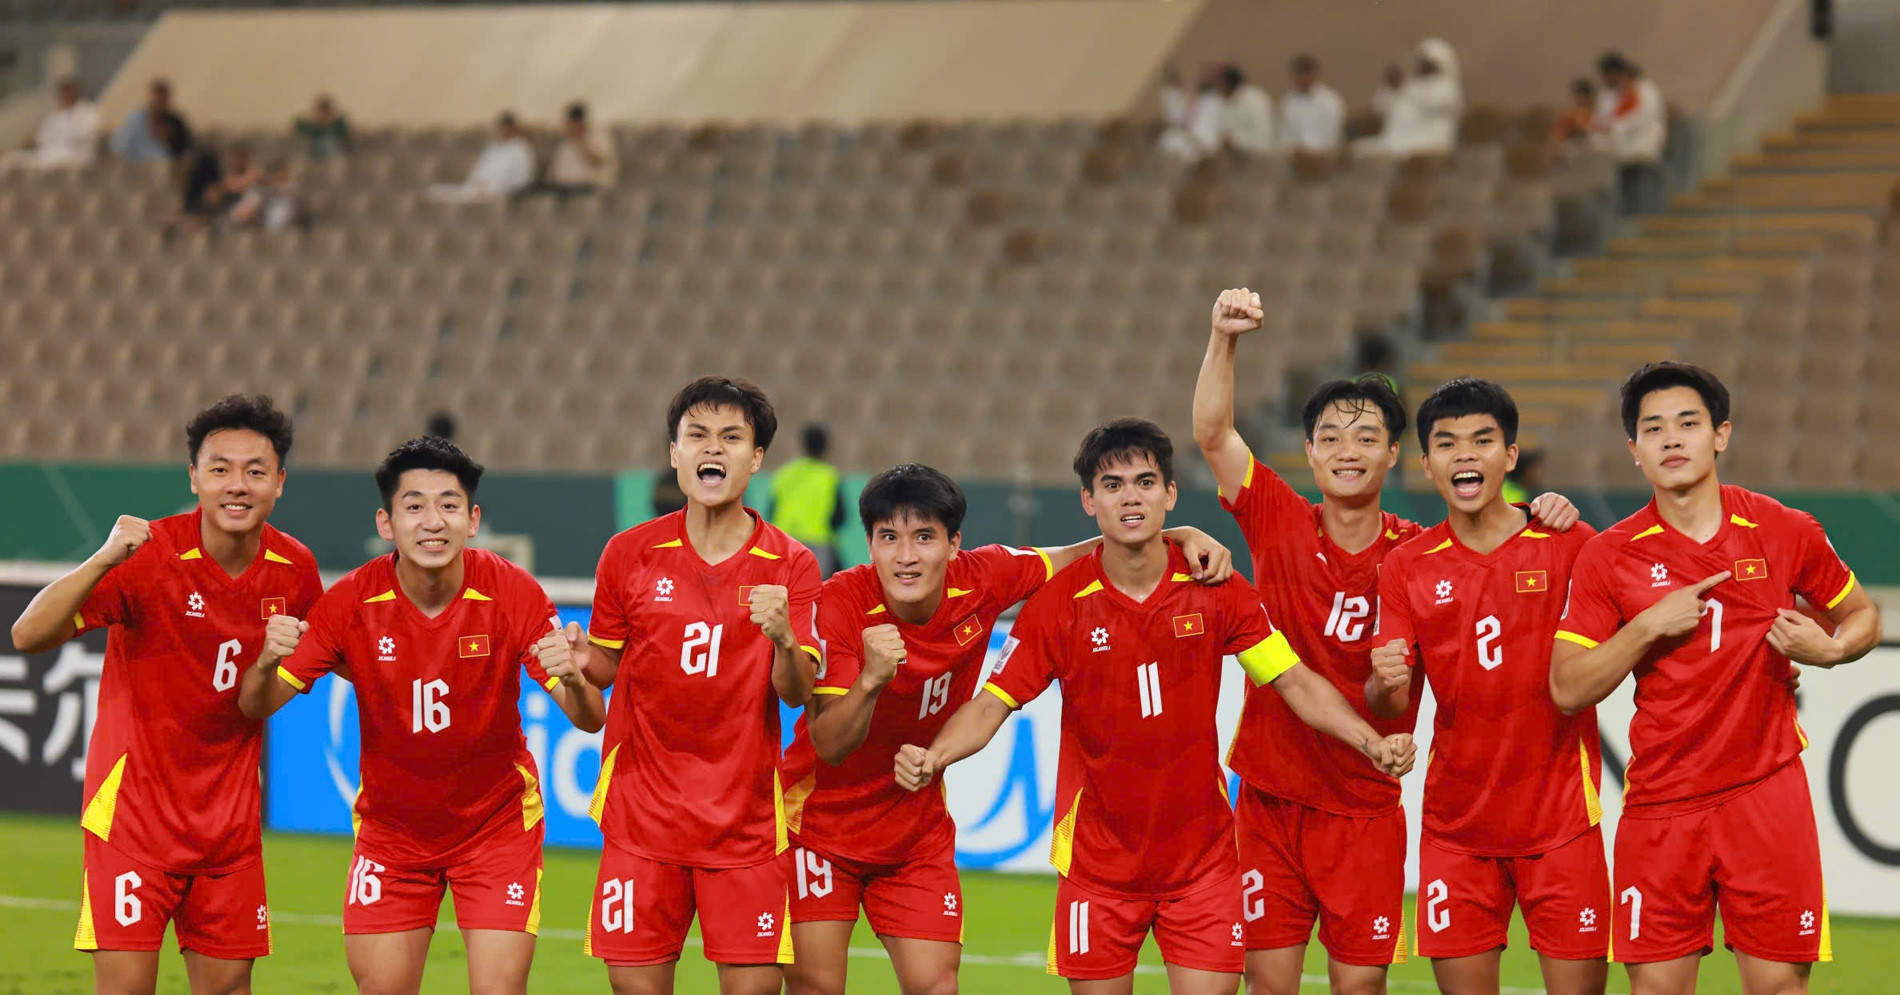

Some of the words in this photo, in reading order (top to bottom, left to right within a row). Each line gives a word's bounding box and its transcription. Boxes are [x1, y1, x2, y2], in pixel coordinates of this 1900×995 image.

[1324, 592, 1369, 641] 12
[1476, 615, 1502, 670] 2
[213, 639, 241, 692] 6
[681, 621, 723, 677] 21
[413, 679, 450, 733] 16
[919, 671, 952, 721] 19
[1137, 662, 1162, 718] 11
[115, 871, 141, 926] 6
[349, 855, 385, 905] 16
[796, 848, 832, 899] 19
[602, 878, 633, 933] 21
[1070, 901, 1089, 954] 11
[1428, 879, 1450, 932] 2
[1622, 886, 1642, 940] 7
